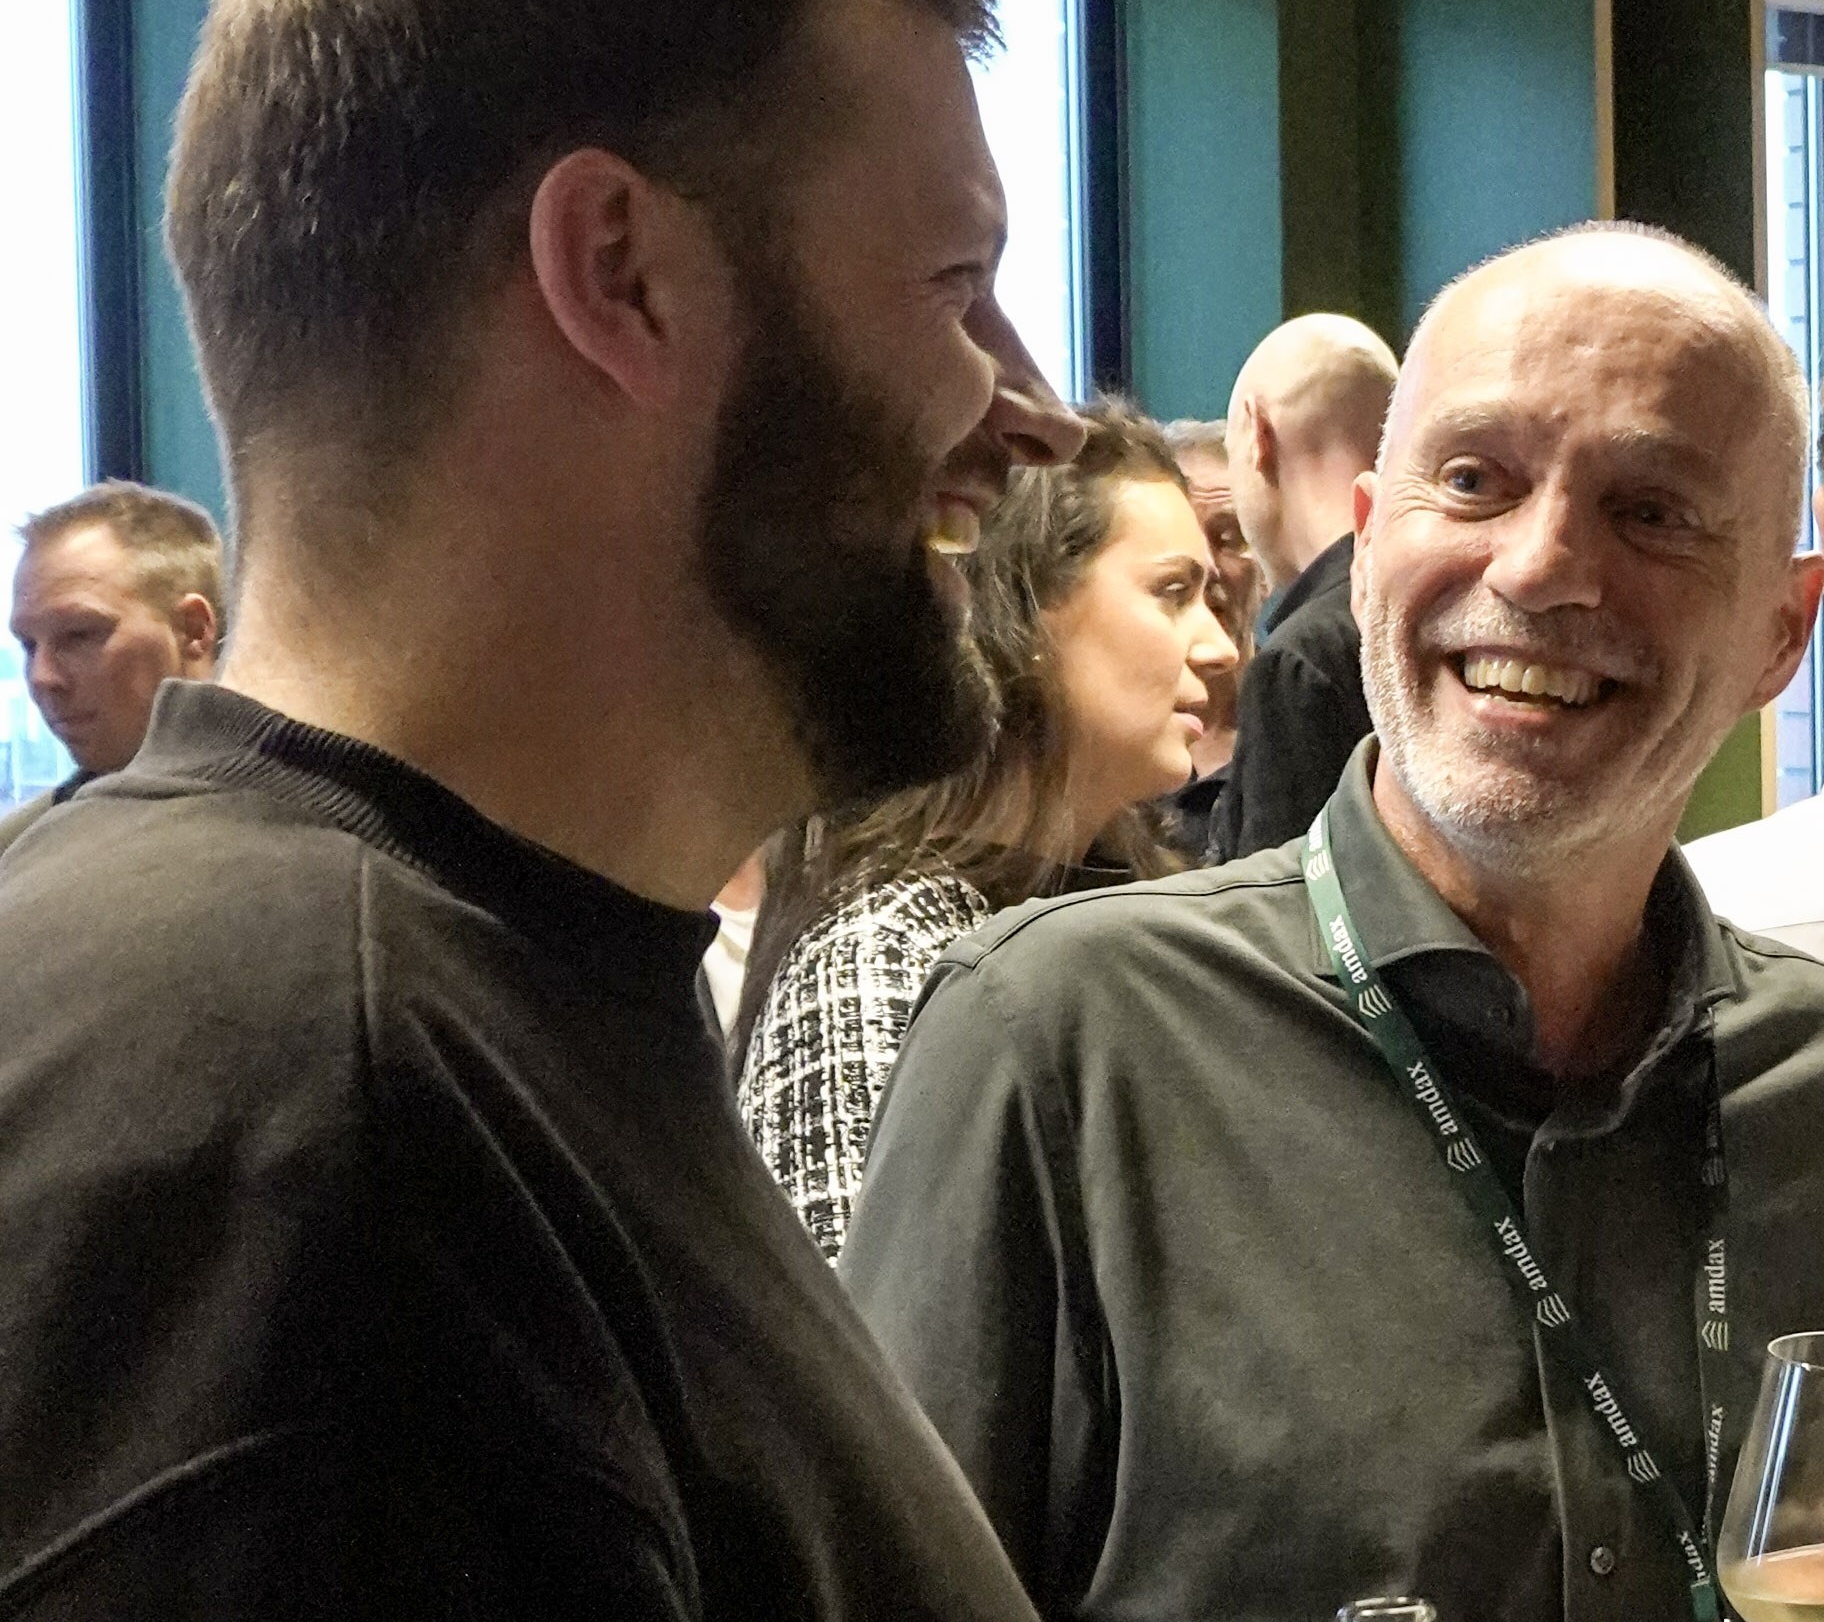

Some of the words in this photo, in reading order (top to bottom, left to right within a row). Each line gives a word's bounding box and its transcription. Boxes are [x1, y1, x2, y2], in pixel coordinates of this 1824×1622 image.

[1329, 915, 1368, 984] amdax
[1407, 1061, 1458, 1136] amdax
[1493, 1216, 1548, 1291] amdax
[1704, 1238, 1726, 1315] amdax
[1584, 1371, 1638, 1448] amdax
